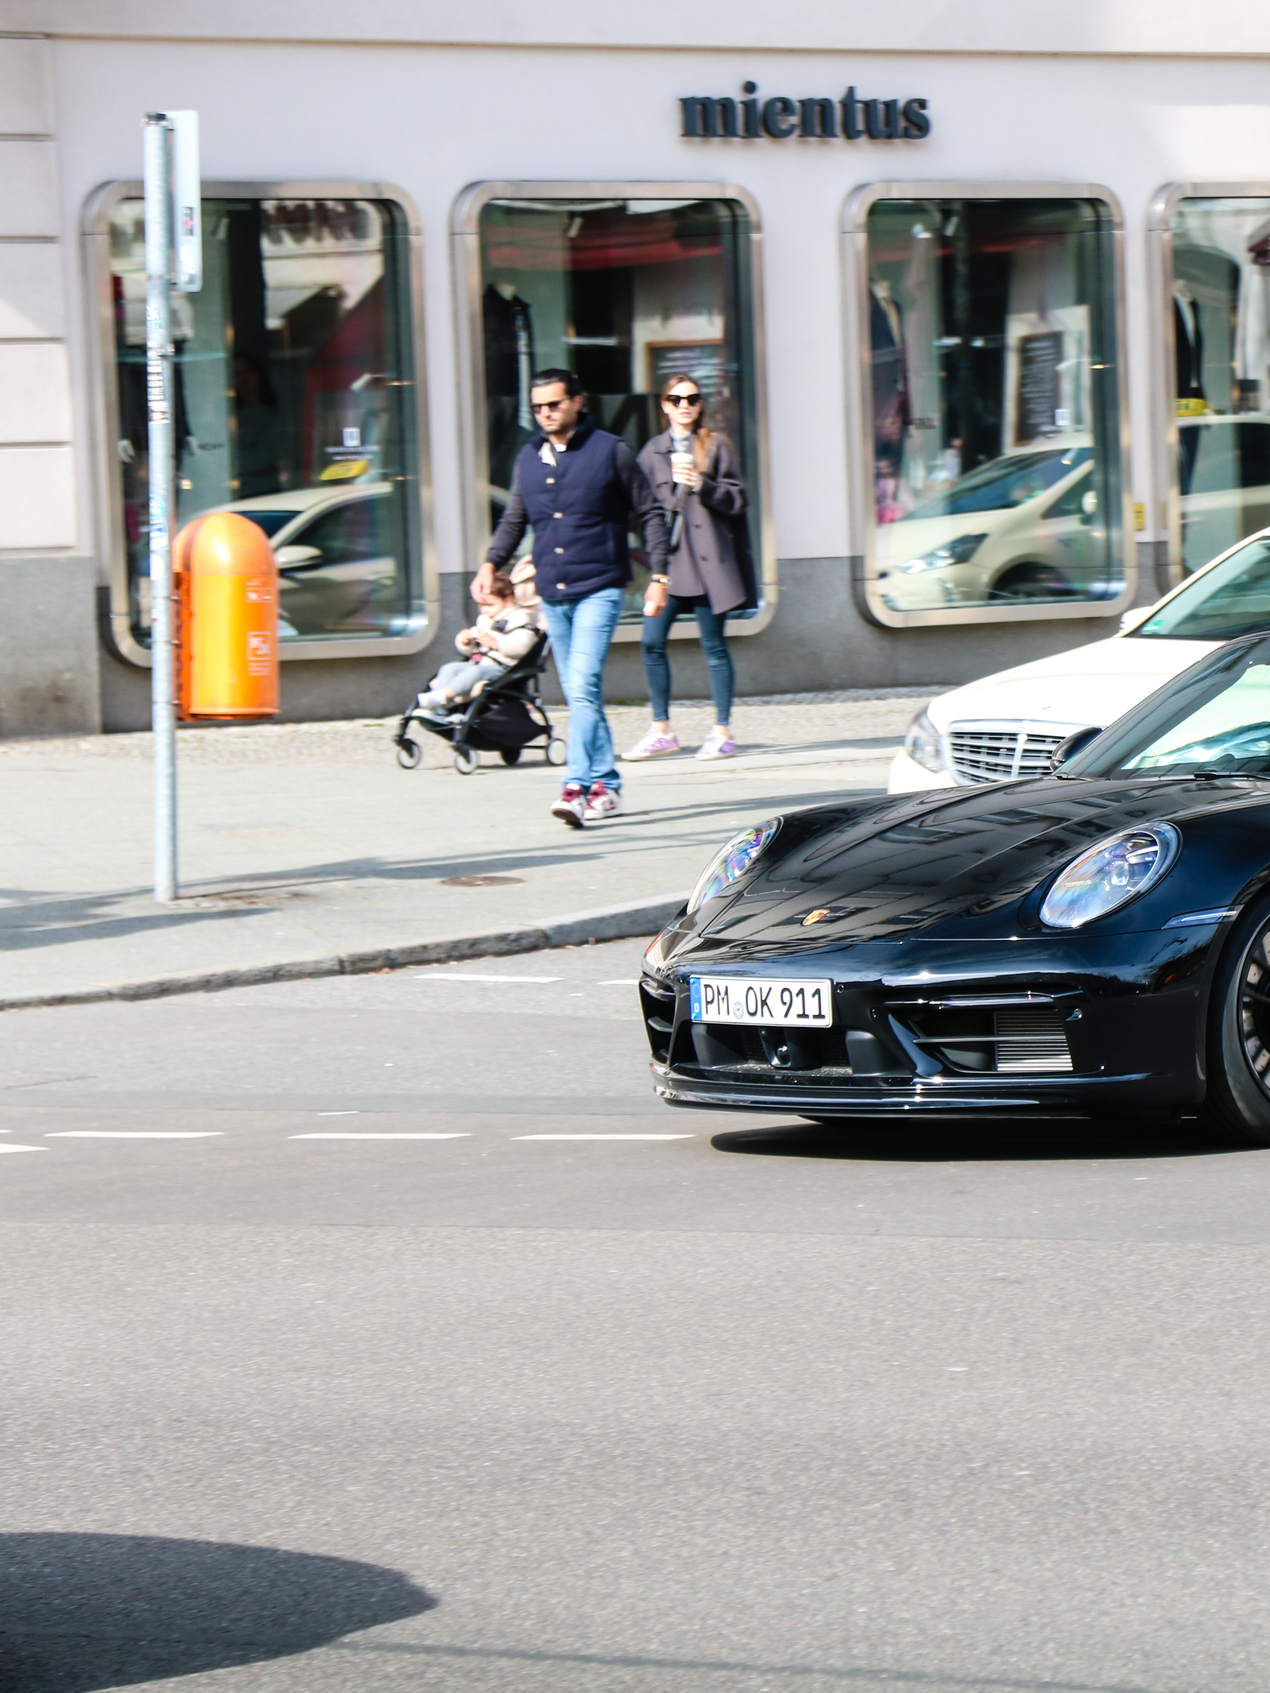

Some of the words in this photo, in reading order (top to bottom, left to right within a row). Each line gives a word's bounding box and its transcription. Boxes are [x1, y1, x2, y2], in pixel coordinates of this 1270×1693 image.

[679, 80, 931, 140] mientus
[703, 983, 730, 1016] PM
[745, 986, 774, 1018] OK
[780, 987, 826, 1020] 911
